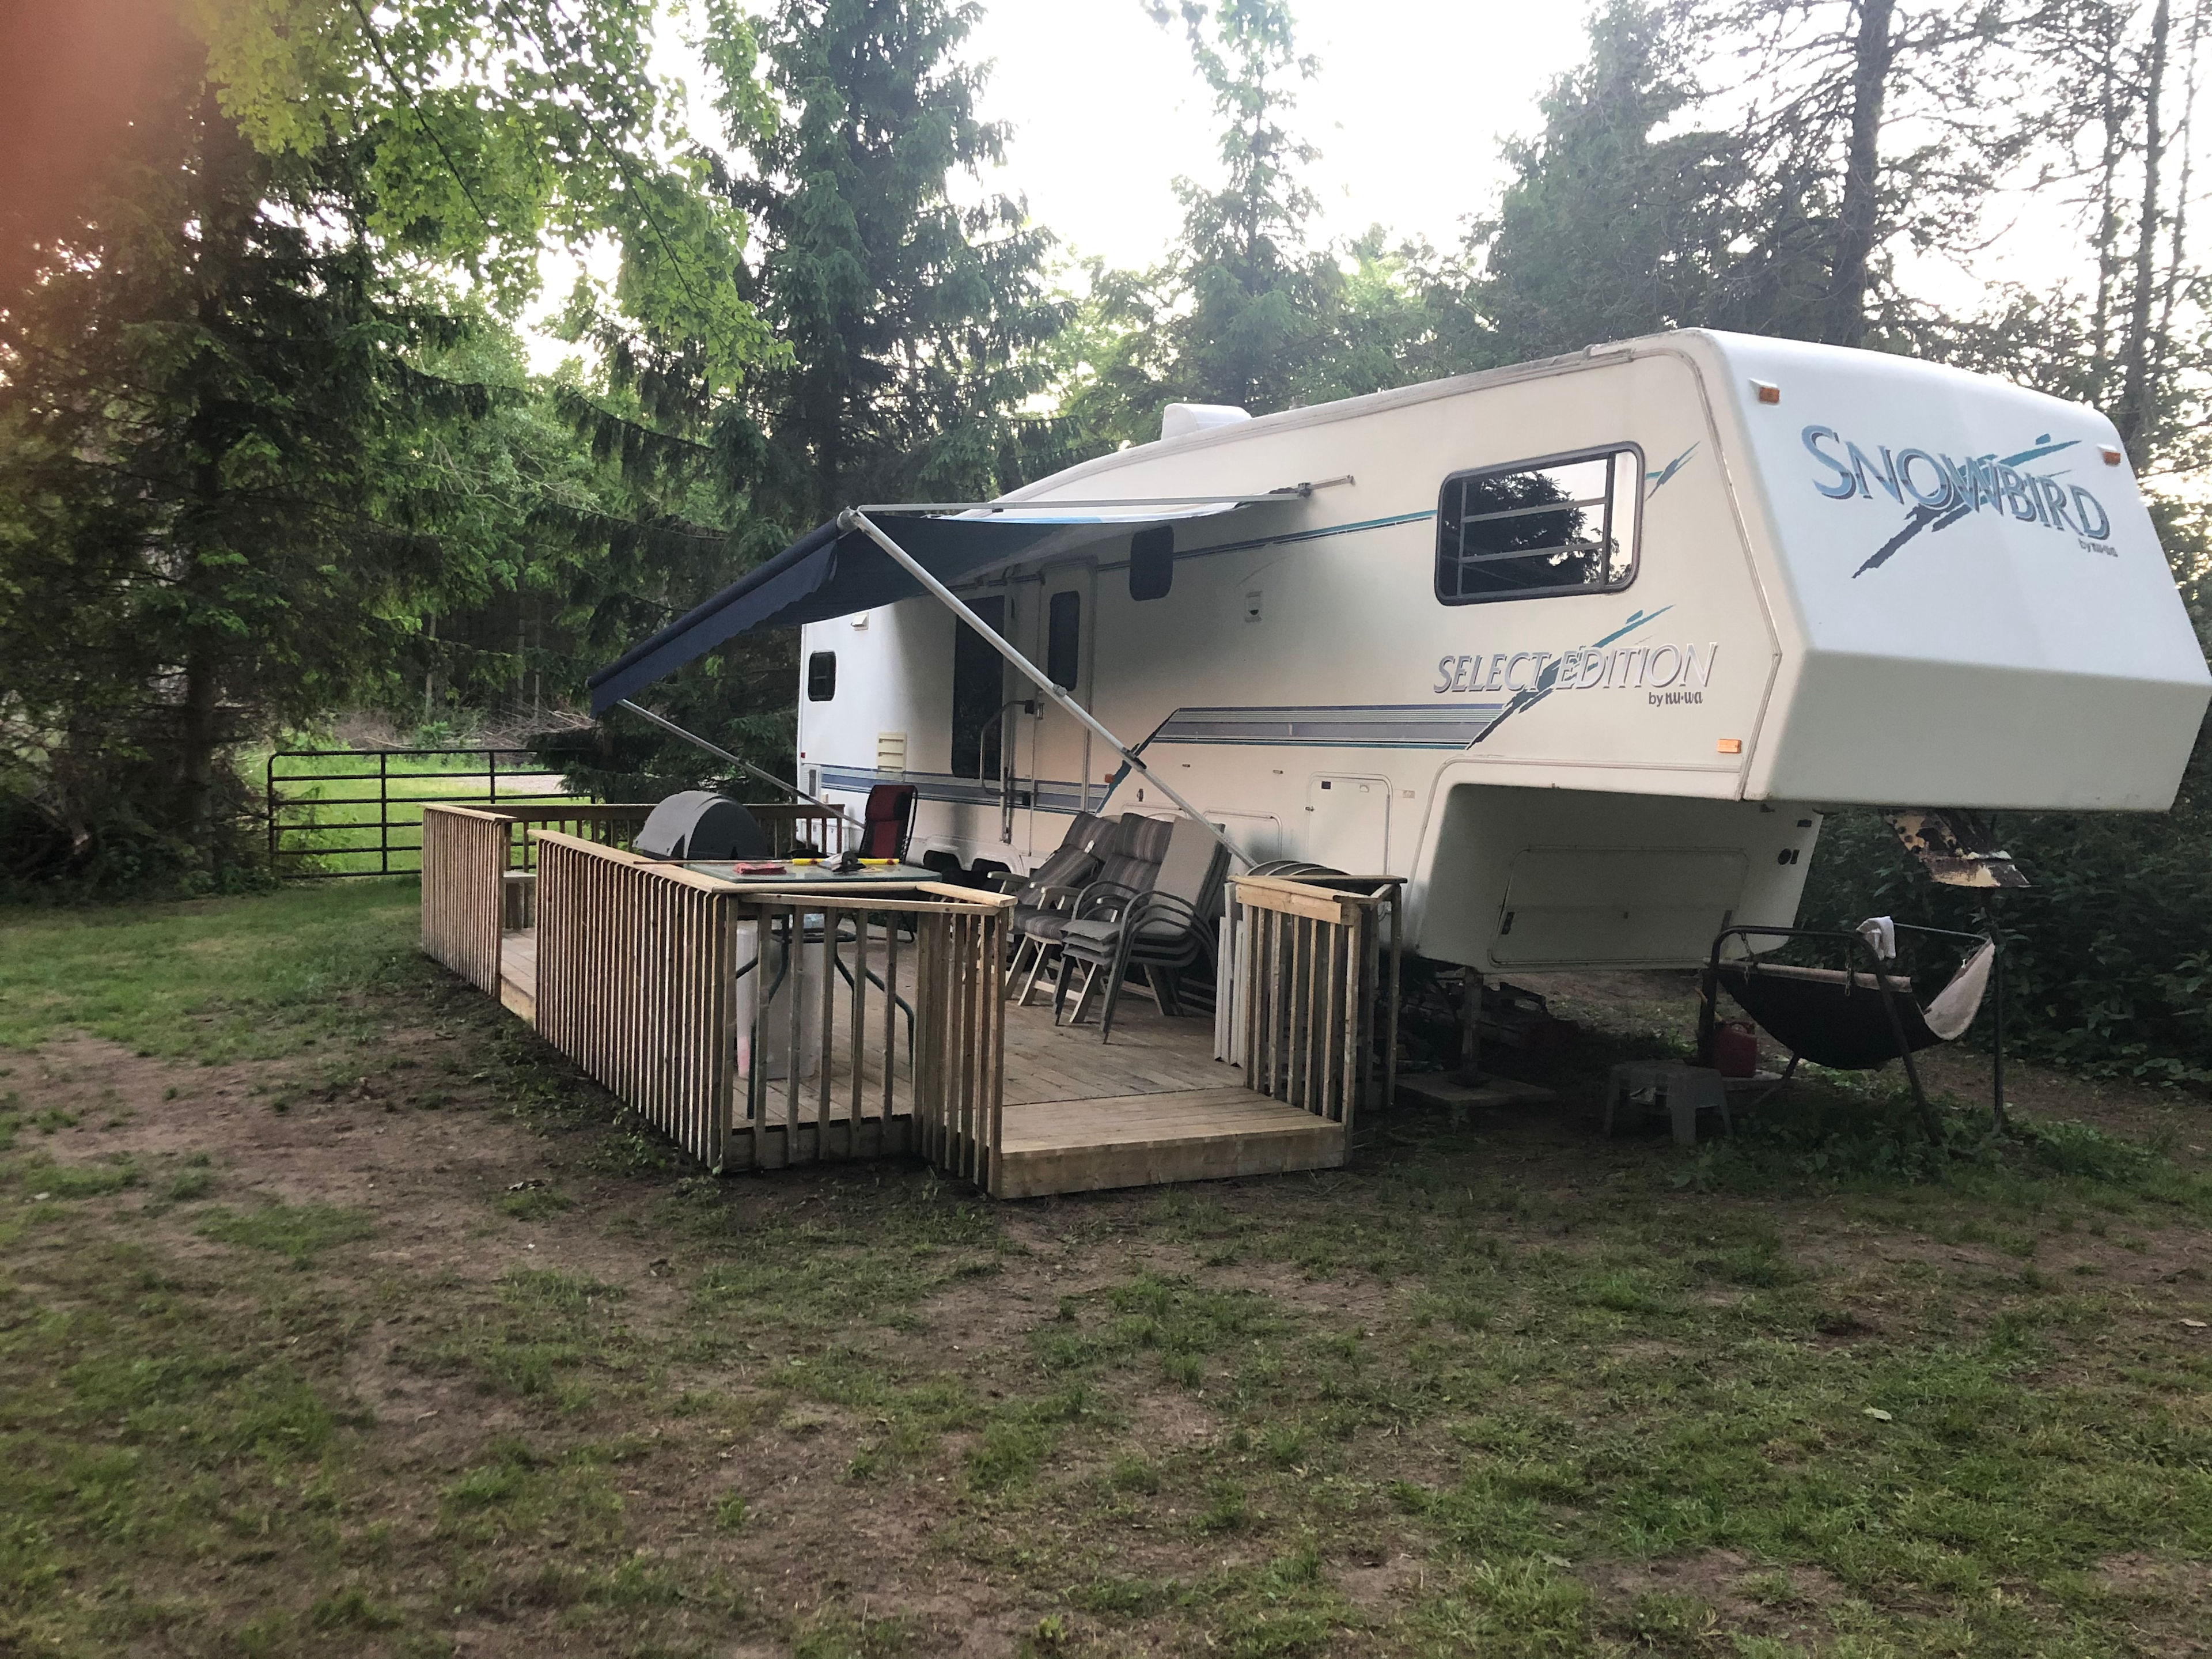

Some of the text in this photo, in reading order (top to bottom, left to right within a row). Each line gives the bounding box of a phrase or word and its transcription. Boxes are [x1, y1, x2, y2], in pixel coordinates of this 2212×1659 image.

[1801, 425, 2111, 540] SNOWBIRD
[1433, 641, 1718, 694] SELECT EDITION
[1648, 691, 1664, 707] by
